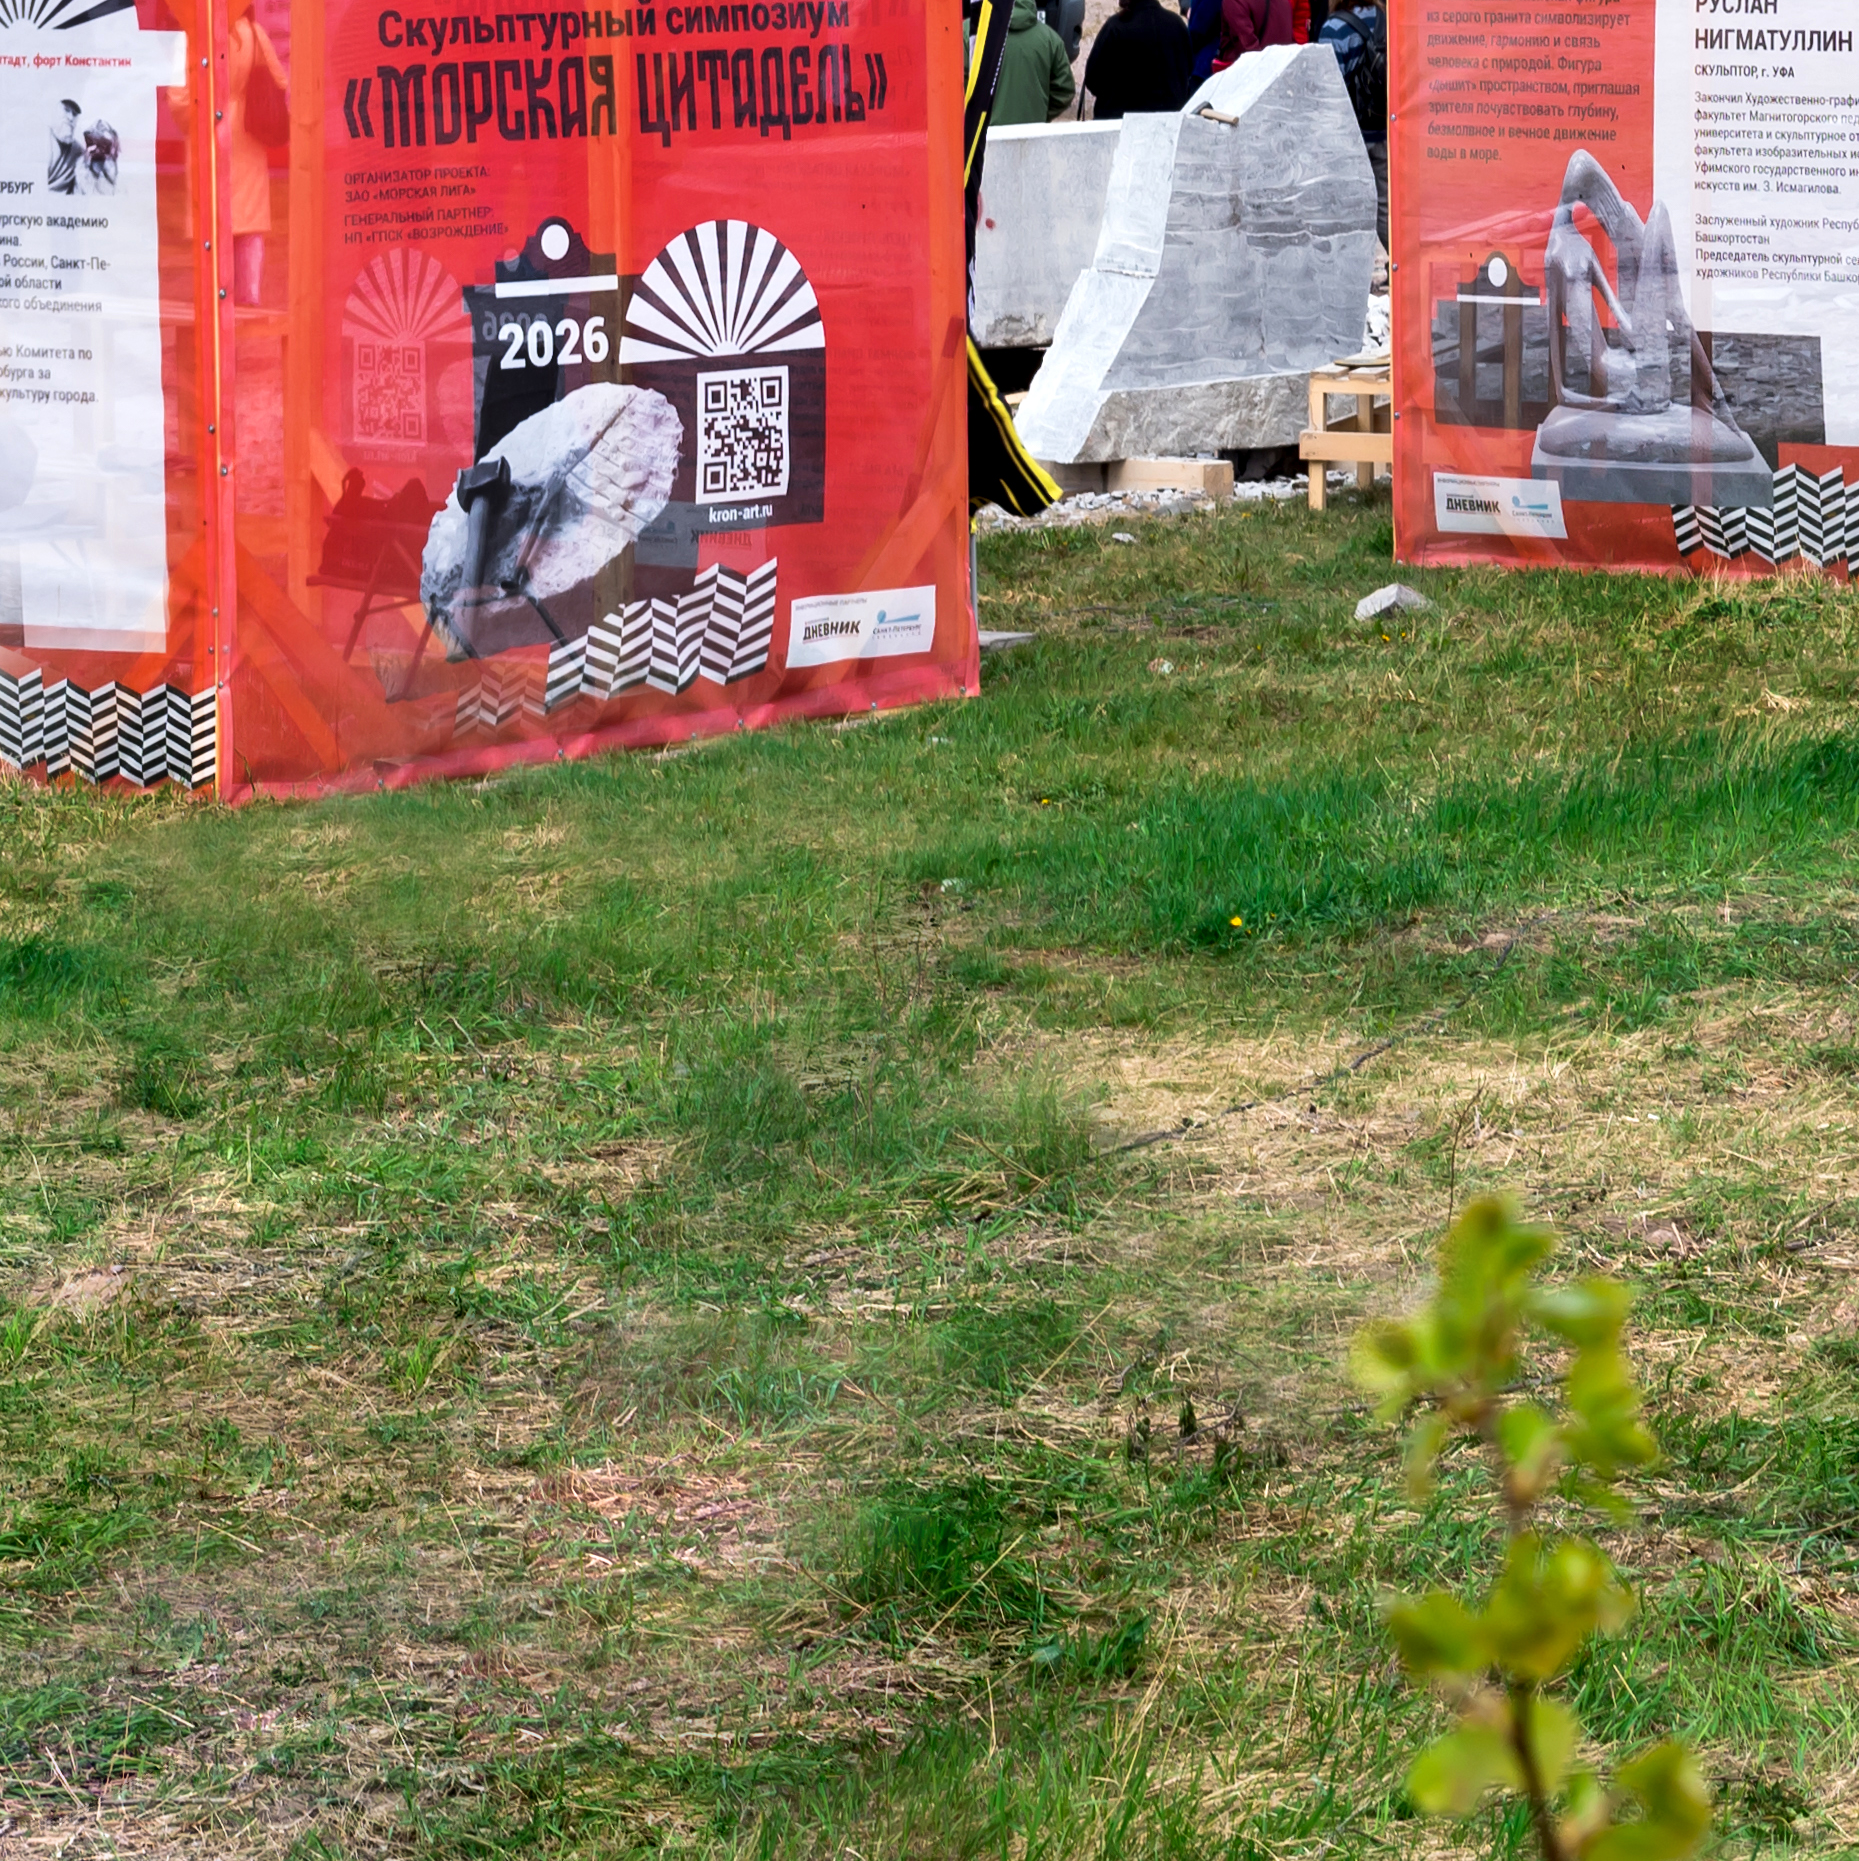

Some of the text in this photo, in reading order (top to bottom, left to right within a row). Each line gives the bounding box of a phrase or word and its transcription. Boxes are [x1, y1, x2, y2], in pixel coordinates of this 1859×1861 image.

[666, 0, 849, 39] симпозиум
[1484, 12, 1630, 29] гранита символизирует
[1490, 36, 1550, 48] гармонию
[1695, 28, 1852, 52] НИГМАТУЛЛИН
[0, 56, 29, 68] тадт,
[1557, 55, 1602, 72] Фигура
[1695, 64, 1795, 80] СКУЛЬПТОР, УФА
[344, 44, 887, 148] «МОРСКАЯ ЦИТАДЕЛЬ»
[1480, 81, 1640, 97] пространством, приглашая
[1694, 92, 1742, 104] Закончил
[1476, 103, 1564, 120] почувствовать
[1694, 110, 1746, 122] факультет
[1750, 110, 1838, 125] Магнитогорского
[1428, 120, 1616, 141] безмолвное вечное движение
[1694, 128, 1763, 140] университета
[1775, 129, 1846, 142] скульптурное
[1694, 144, 1752, 158] факультета
[1756, 146, 1846, 160] изобразительных
[344, 168, 431, 185] ОРГАНИЗАТОР
[1694, 162, 1750, 176] Уфимского
[1753, 164, 1846, 178] государственного
[0, 182, 34, 194] РБУРГ
[1776, 182, 1842, 195] Исмагилова.
[46, 216, 109, 230] академию
[344, 208, 434, 226] ГЕНЕРАЛЬНЫЙ
[1696, 214, 1766, 228] Заслуженный
[1770, 218, 1820, 230] художник
[407, 223, 509, 240] «ВОЗРОЖДЕНИЕ»
[1696, 231, 1770, 246] Башкортостан
[1696, 248, 1770, 264] Председатель
[1772, 252, 1842, 266] скульптурной
[15, 275, 62, 289] области
[1696, 268, 1758, 280] художников
[1762, 268, 1822, 283] Республики
[24, 296, 102, 312] объединения
[498, 316, 610, 370] 2026
[709, 503, 773, 523] kron-art.ru
[1446, 498, 1500, 513] ДНЕВНИК
[803, 619, 861, 642] ДНЕВНИК
